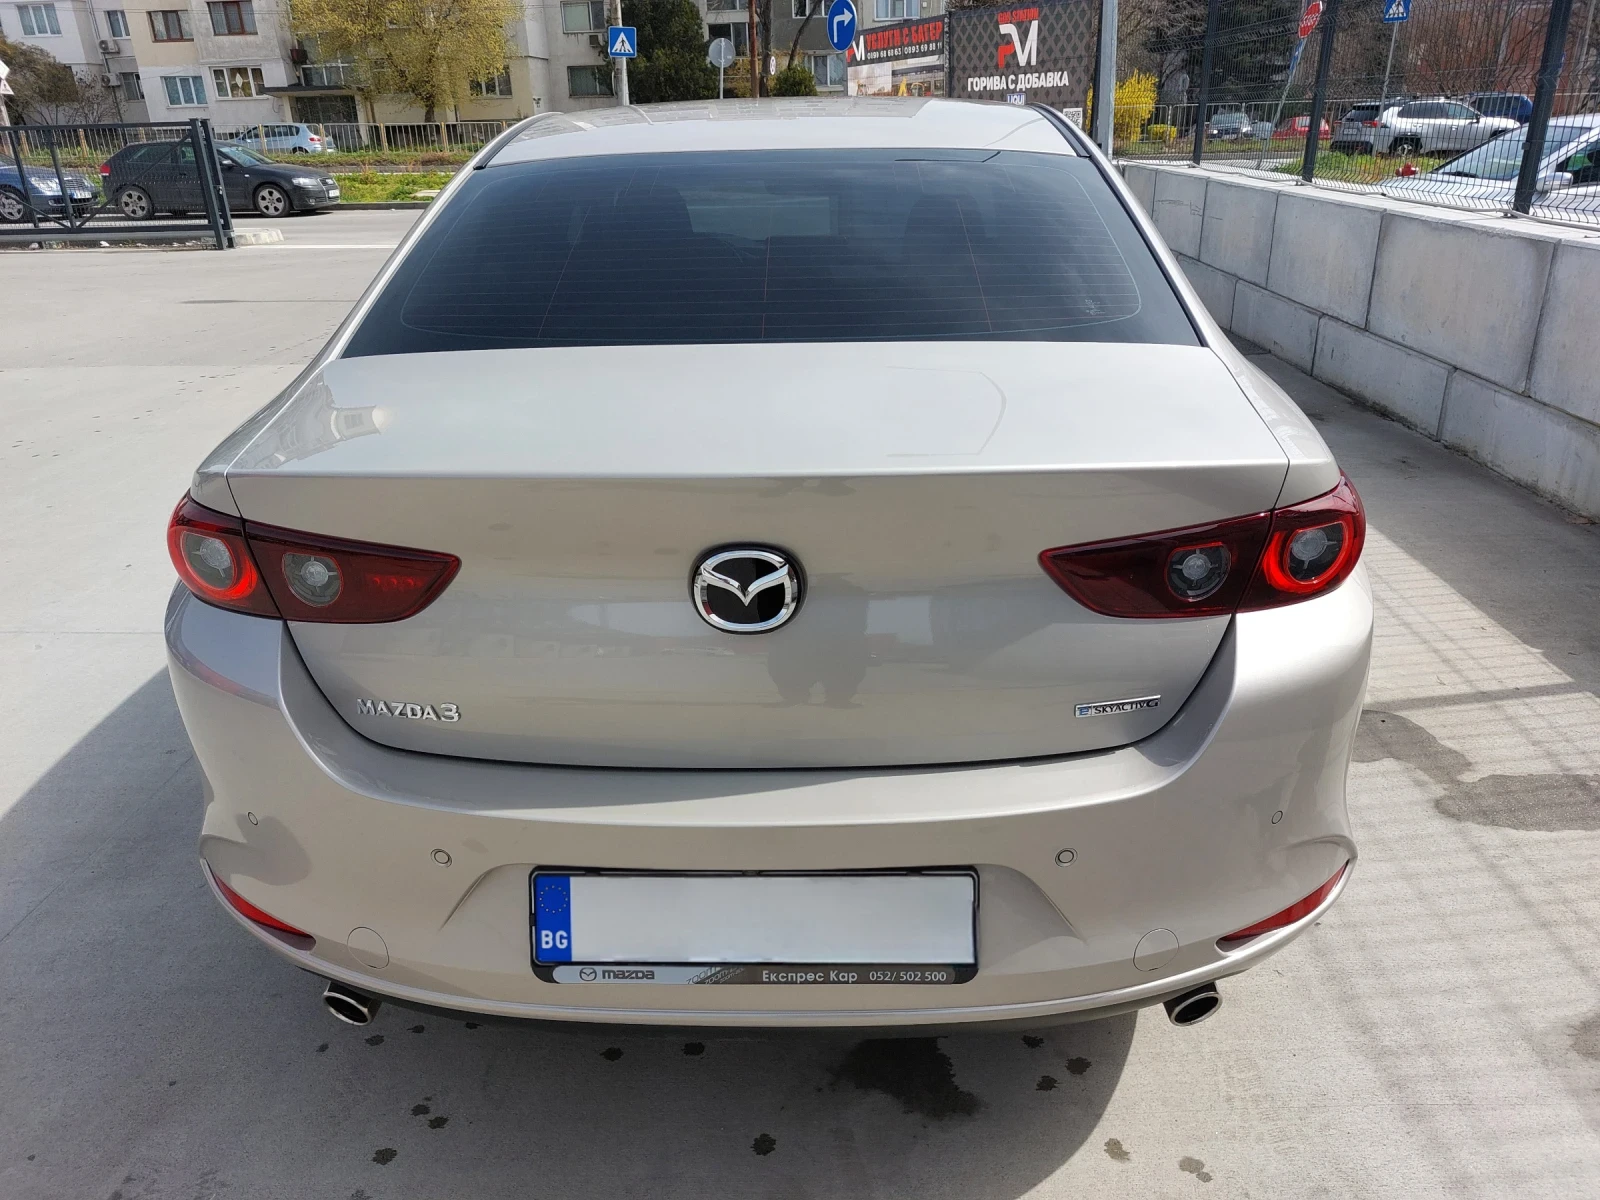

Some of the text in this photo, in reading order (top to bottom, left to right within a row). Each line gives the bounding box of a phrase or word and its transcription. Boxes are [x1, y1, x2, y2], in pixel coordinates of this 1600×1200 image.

[866, 29, 900, 50] УСЛУГИ
[911, 21, 943, 43] БАГЕР
[968, 71, 1069, 91] ГОРИВА С ДОБАВКА
[541, 930, 568, 949] BG
[602, 969, 655, 980] mazda
[762, 970, 947, 984] Експрес Кар 052/ 502 500
